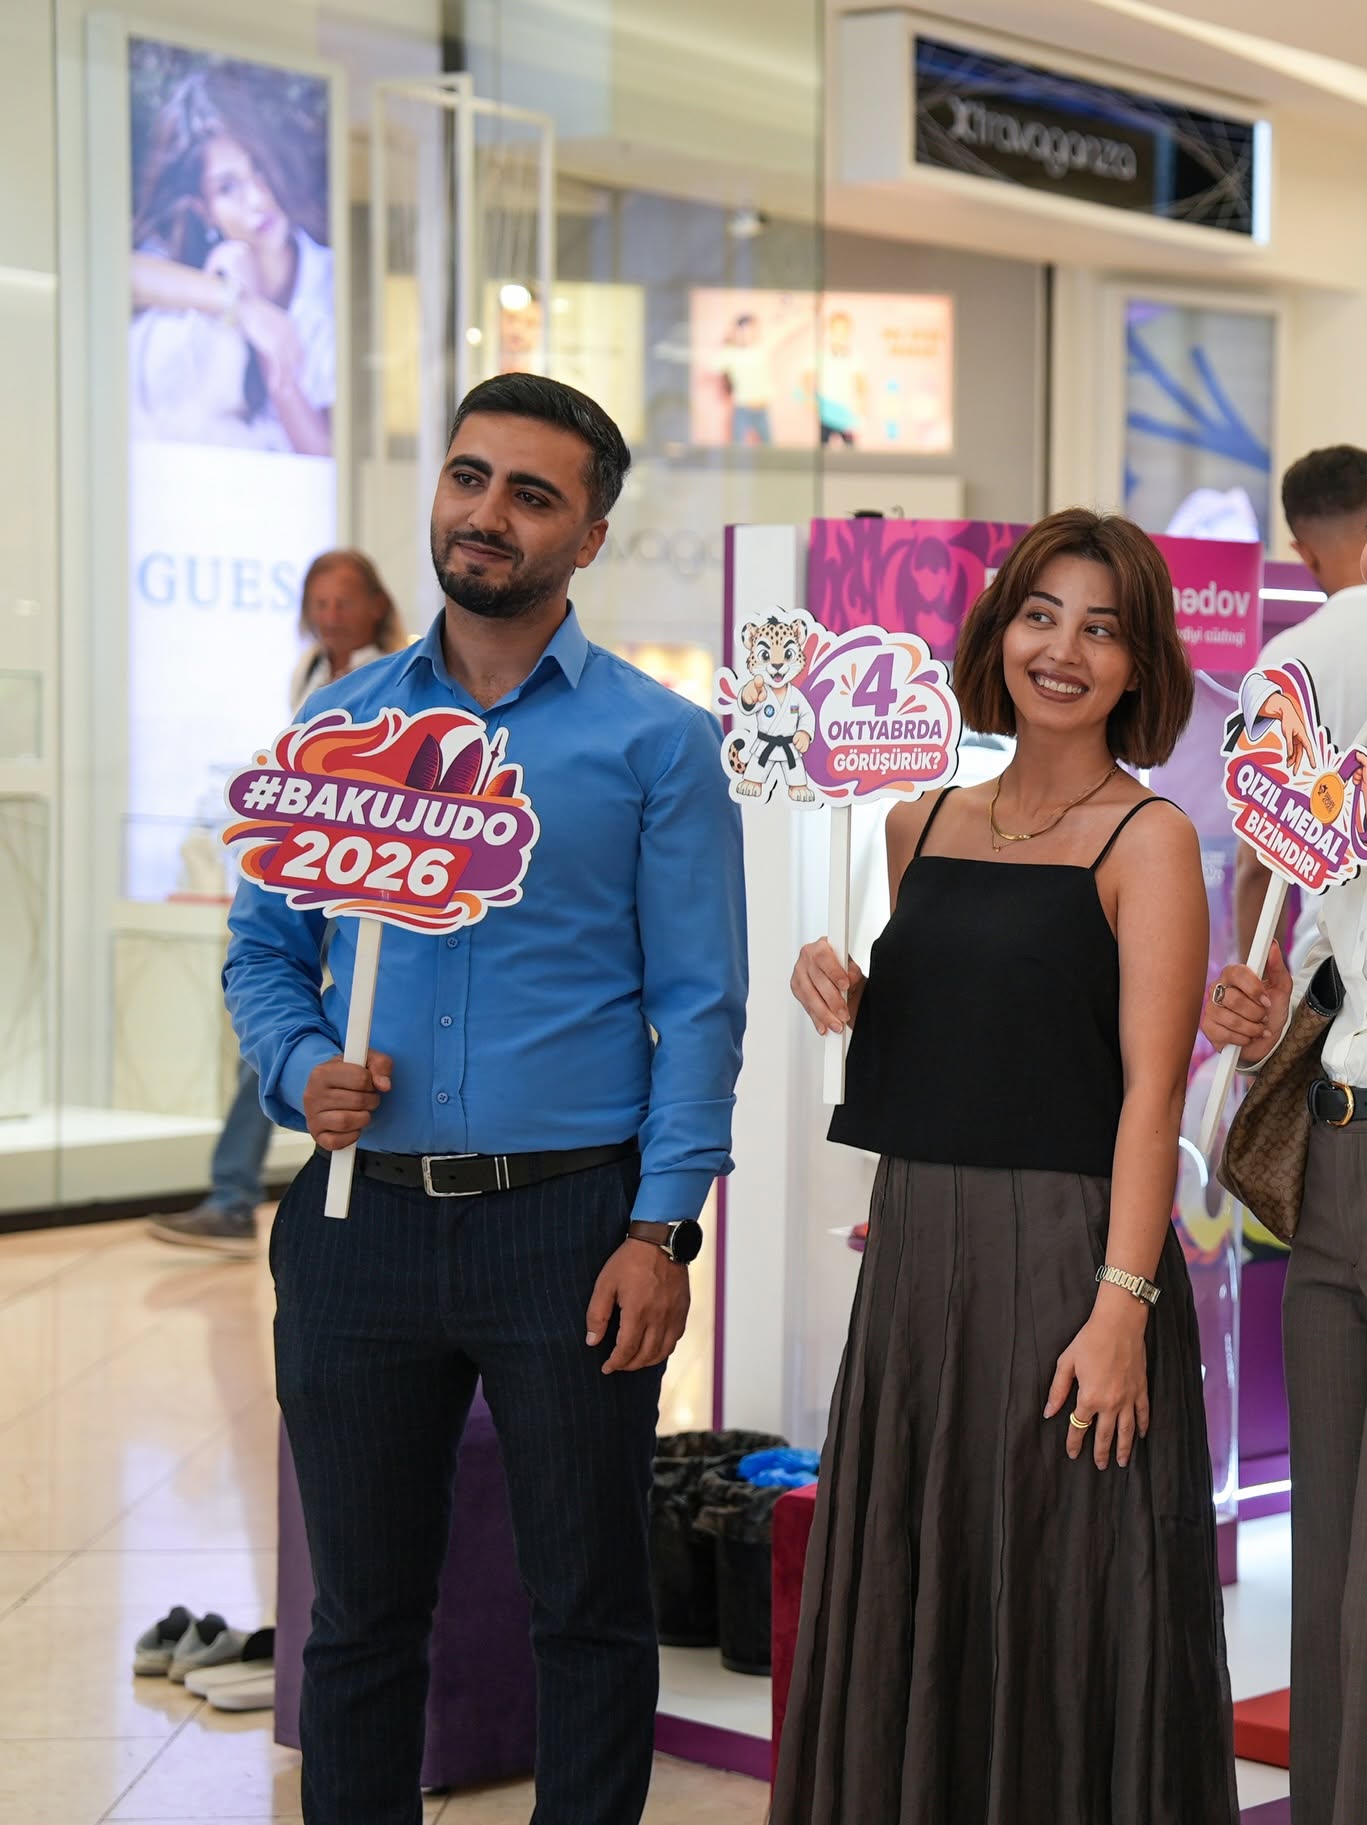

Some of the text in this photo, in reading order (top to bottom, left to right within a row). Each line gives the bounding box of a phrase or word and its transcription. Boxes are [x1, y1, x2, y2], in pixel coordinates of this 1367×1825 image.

[137, 549, 300, 610] GUES
[1172, 581, 1250, 618] ədov
[852, 653, 898, 717] 4
[828, 719, 942, 741] OKTYABRDA
[833, 748, 942, 775] GÖRÜŞÜRÜK?
[242, 775, 518, 846] #BAKUJUDO
[1237, 764, 1342, 864] QIZIL MEDAL
[281, 829, 455, 897] 2026
[1244, 809, 1321, 882] BİZİMDİR!
